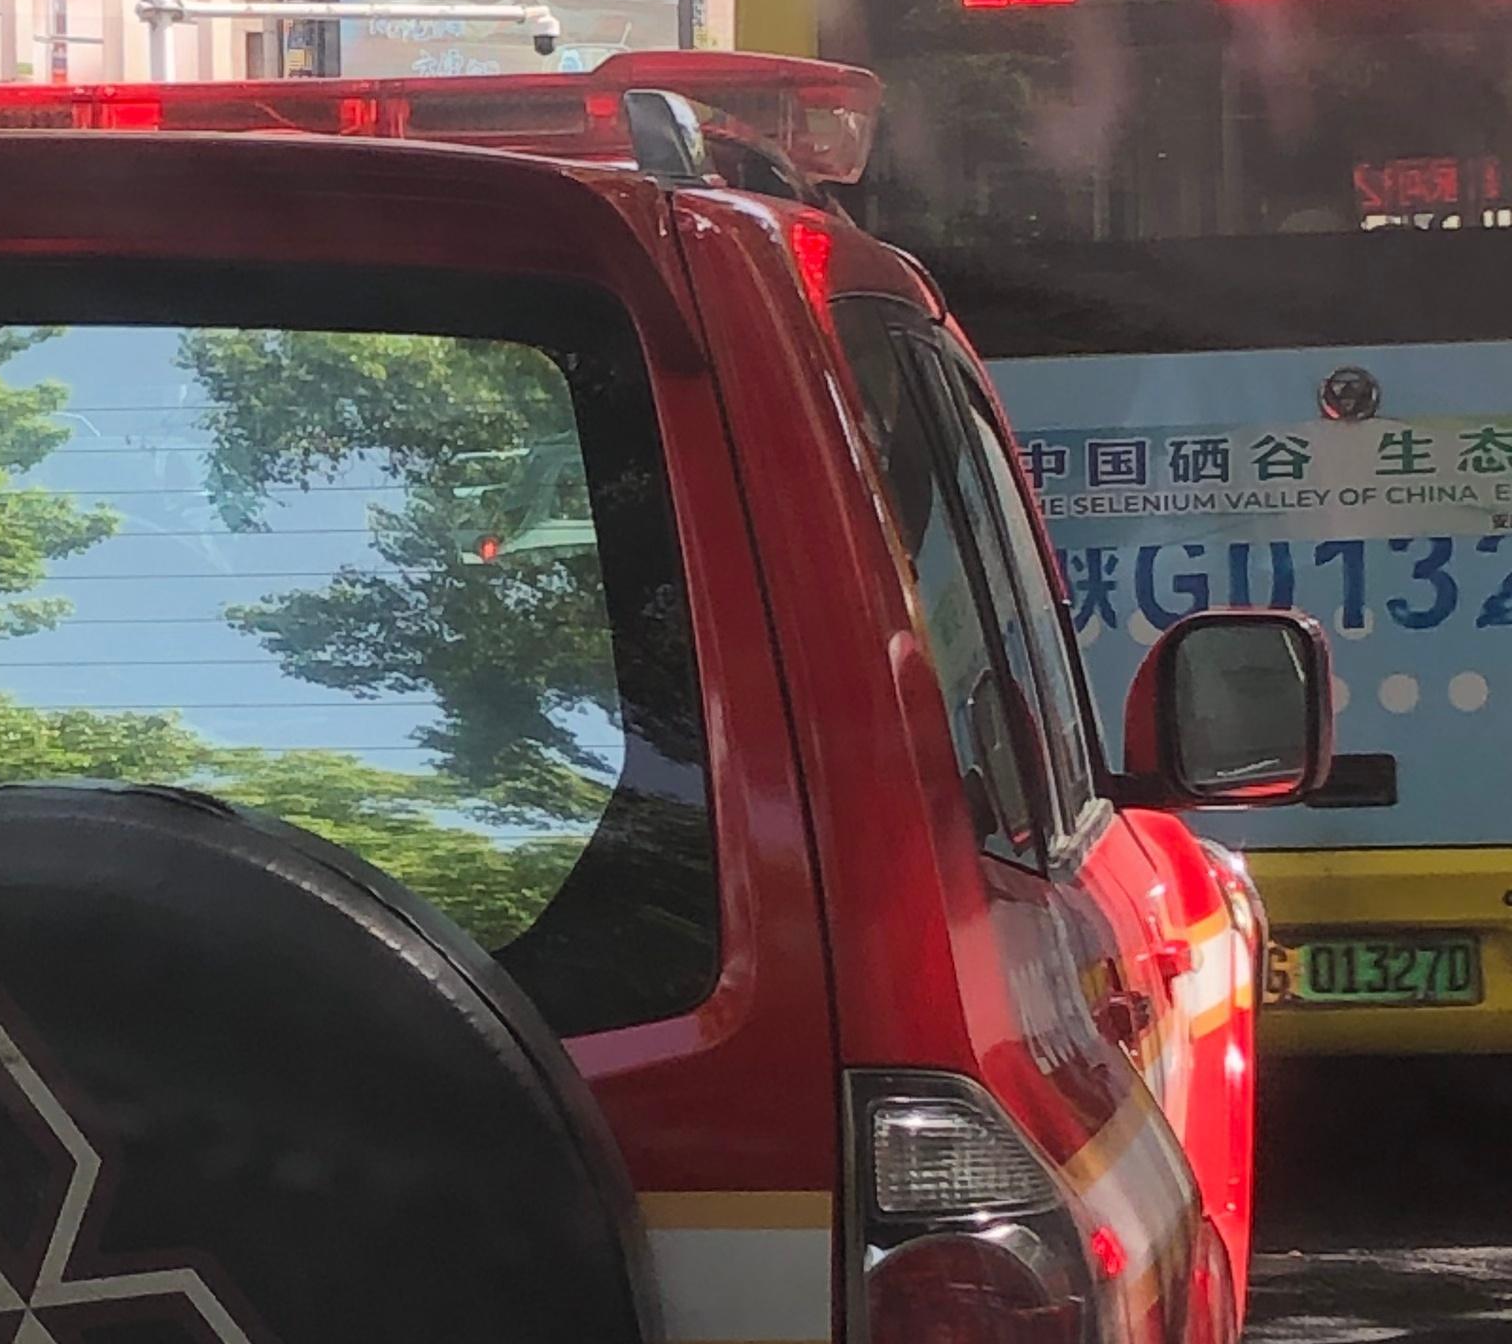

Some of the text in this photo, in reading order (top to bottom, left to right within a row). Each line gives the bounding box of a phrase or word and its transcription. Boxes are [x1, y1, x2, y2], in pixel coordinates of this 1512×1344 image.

[1021, 426, 1512, 489] 中国硒谷 生态
[1074, 493, 1217, 515] SELENIUM
[1225, 488, 1330, 510] VALLEY
[1339, 487, 1377, 506] OF
[1385, 484, 1478, 505] CHINA
